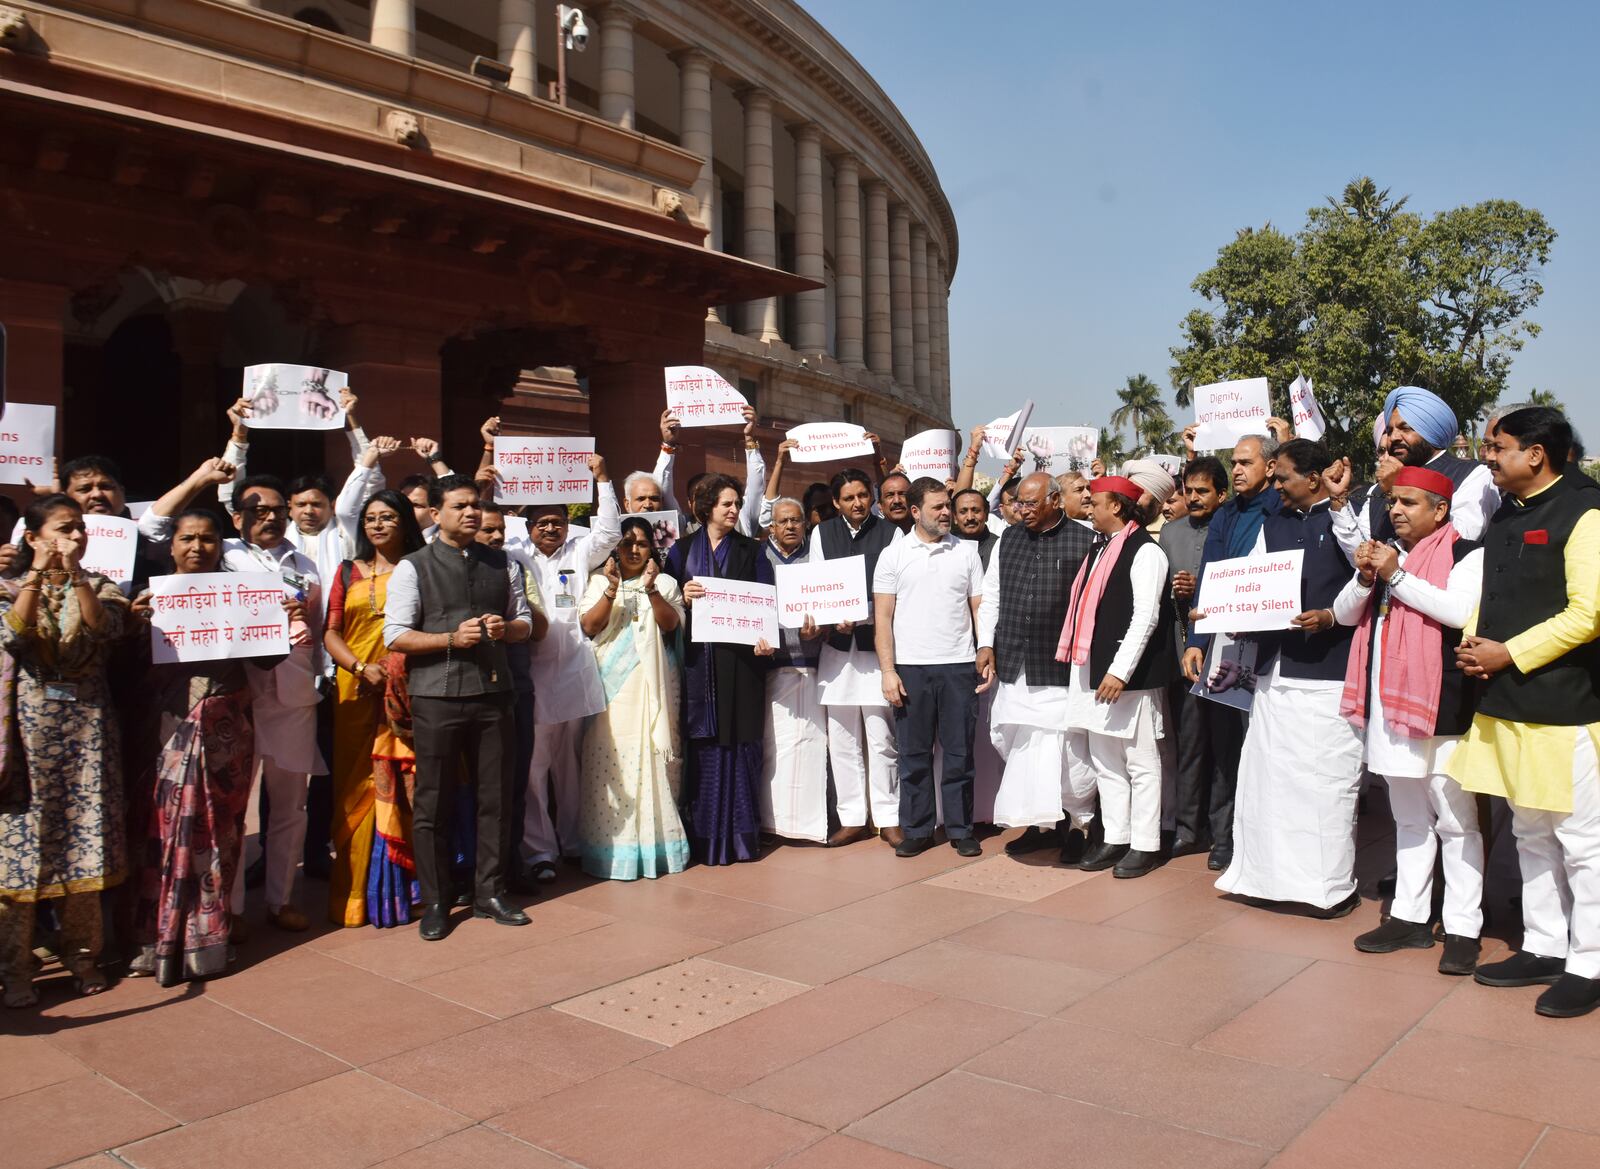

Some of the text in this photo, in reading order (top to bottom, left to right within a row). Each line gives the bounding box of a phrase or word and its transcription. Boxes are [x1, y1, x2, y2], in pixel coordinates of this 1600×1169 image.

[1210, 391, 1243, 404] Dignity,
[1200, 406, 1265, 423] NOT Handcuffs
[808, 431, 849, 441] Humans
[797, 440, 866, 453] NOT Prisoners
[547, 447, 555, 464] में
[502, 475, 589, 495] नहीं सहेंगे ये अपमान
[1209, 560, 1295, 580] Indians insulted,
[801, 582, 845, 594] Humans
[1235, 582, 1261, 593] India
[156, 585, 217, 613] हथकड़ियों
[222, 584, 233, 606] में
[785, 597, 860, 612] NOT Prisoners
[1236, 602, 1258, 613] stay
[1261, 599, 1295, 610] Silent
[163, 621, 282, 649] नहीं सहेंगे ये अपमान
